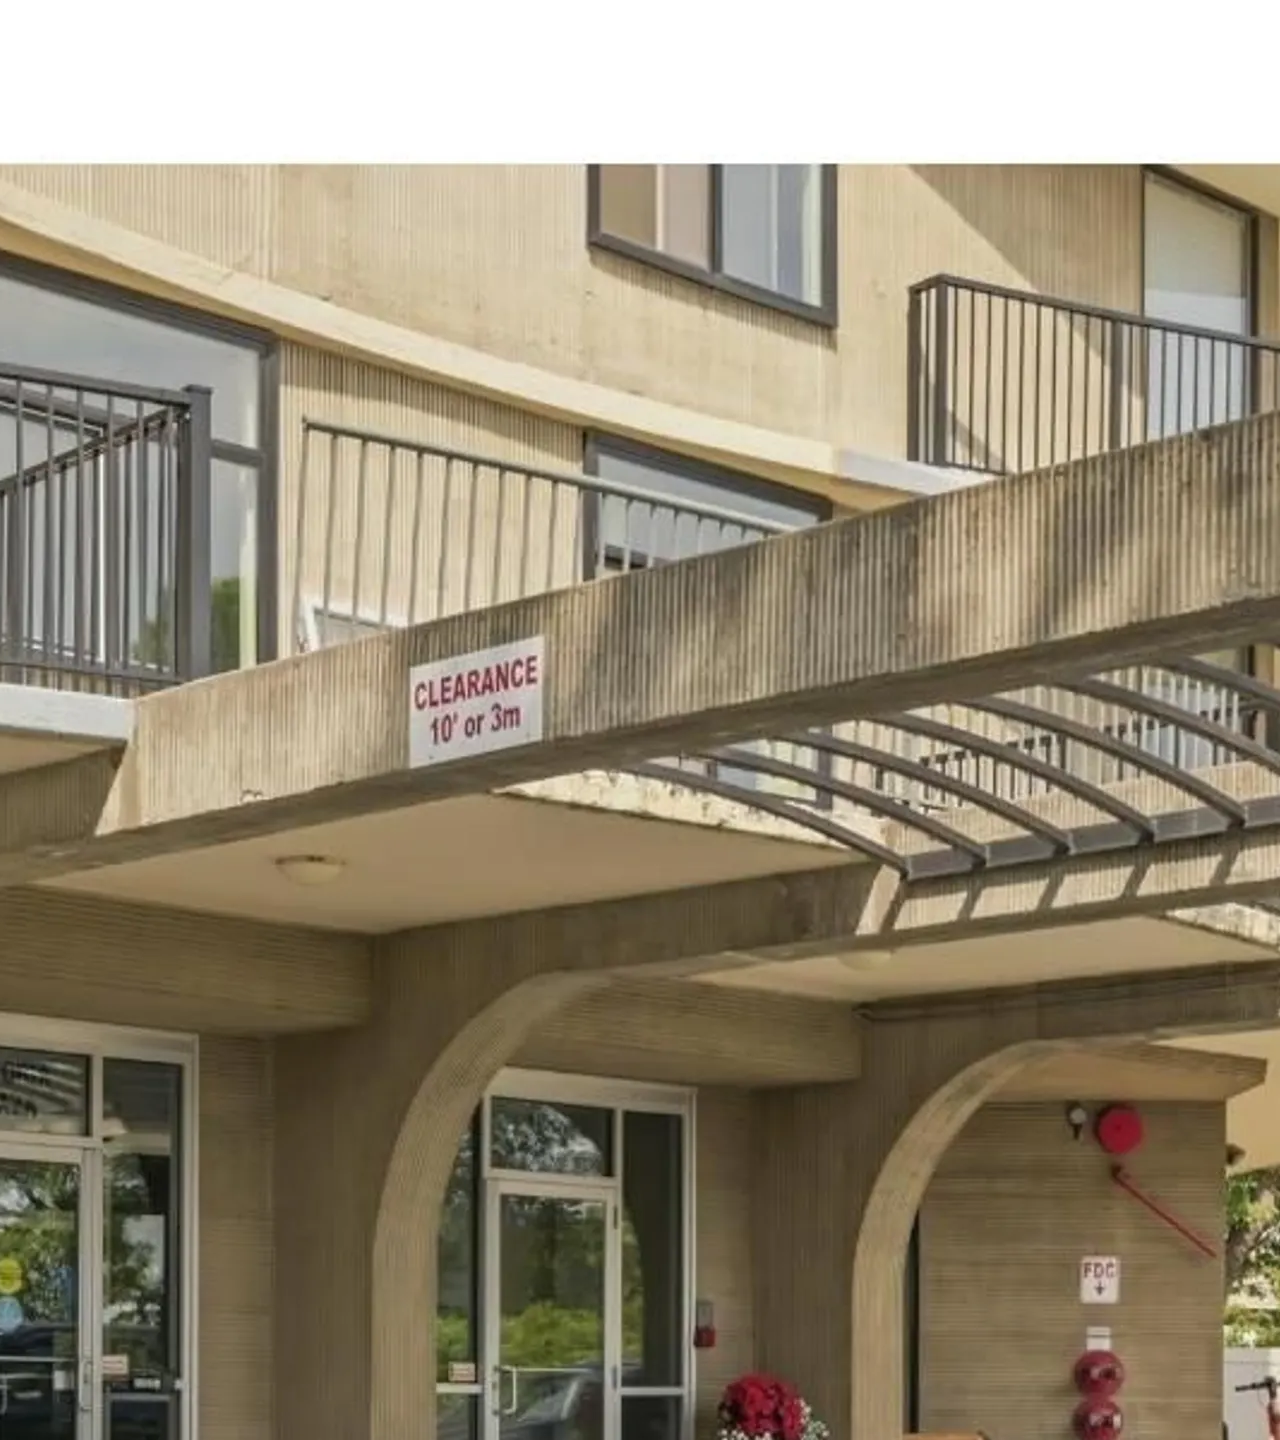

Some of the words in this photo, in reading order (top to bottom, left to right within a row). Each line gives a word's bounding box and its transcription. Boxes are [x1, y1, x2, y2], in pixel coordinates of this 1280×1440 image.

[413, 655, 538, 711] CLEARANCE
[430, 712, 458, 746] 10'
[463, 714, 485, 739] or
[490, 702, 521, 733] 3m
[1083, 1262, 1116, 1279] FDC
